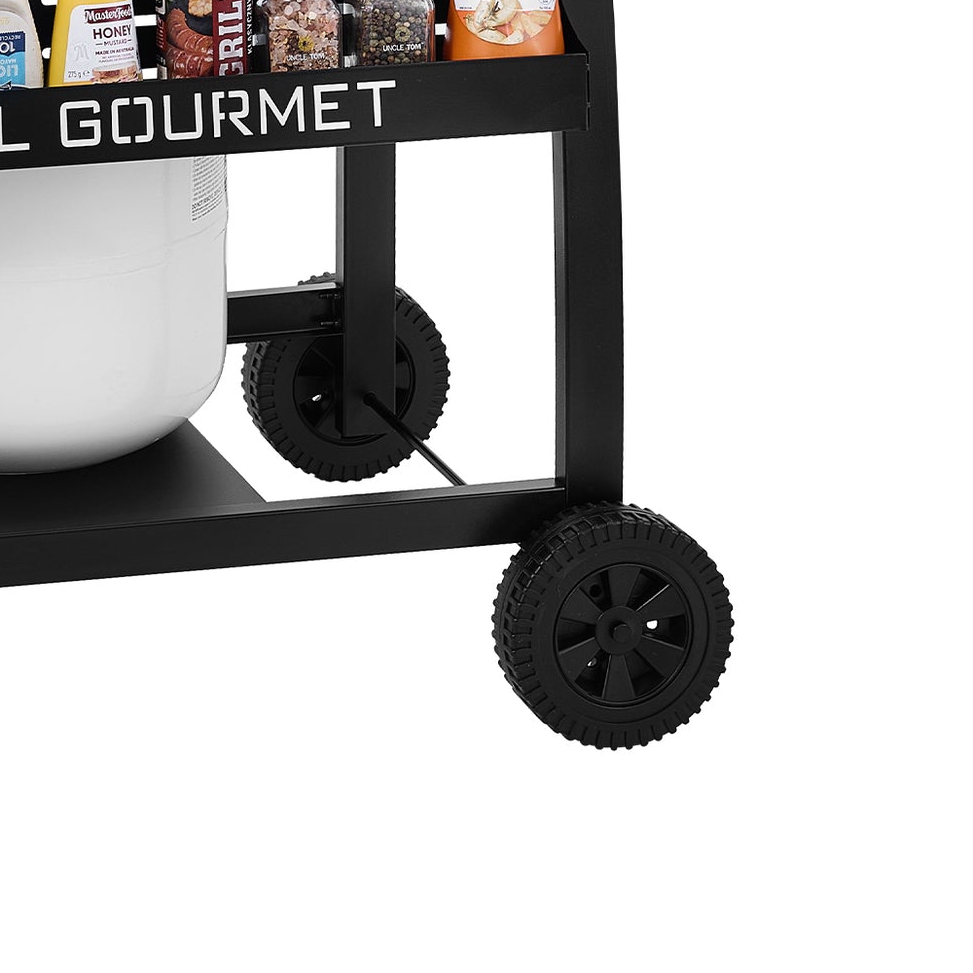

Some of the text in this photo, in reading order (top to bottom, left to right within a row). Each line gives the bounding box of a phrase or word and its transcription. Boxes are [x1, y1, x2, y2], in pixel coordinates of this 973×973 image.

[84, 6, 132, 23] MasterFood
[93, 25, 132, 40] HONEY
[382, 44, 404, 52] UNCLE
[59, 80, 397, 148] GOURMET
